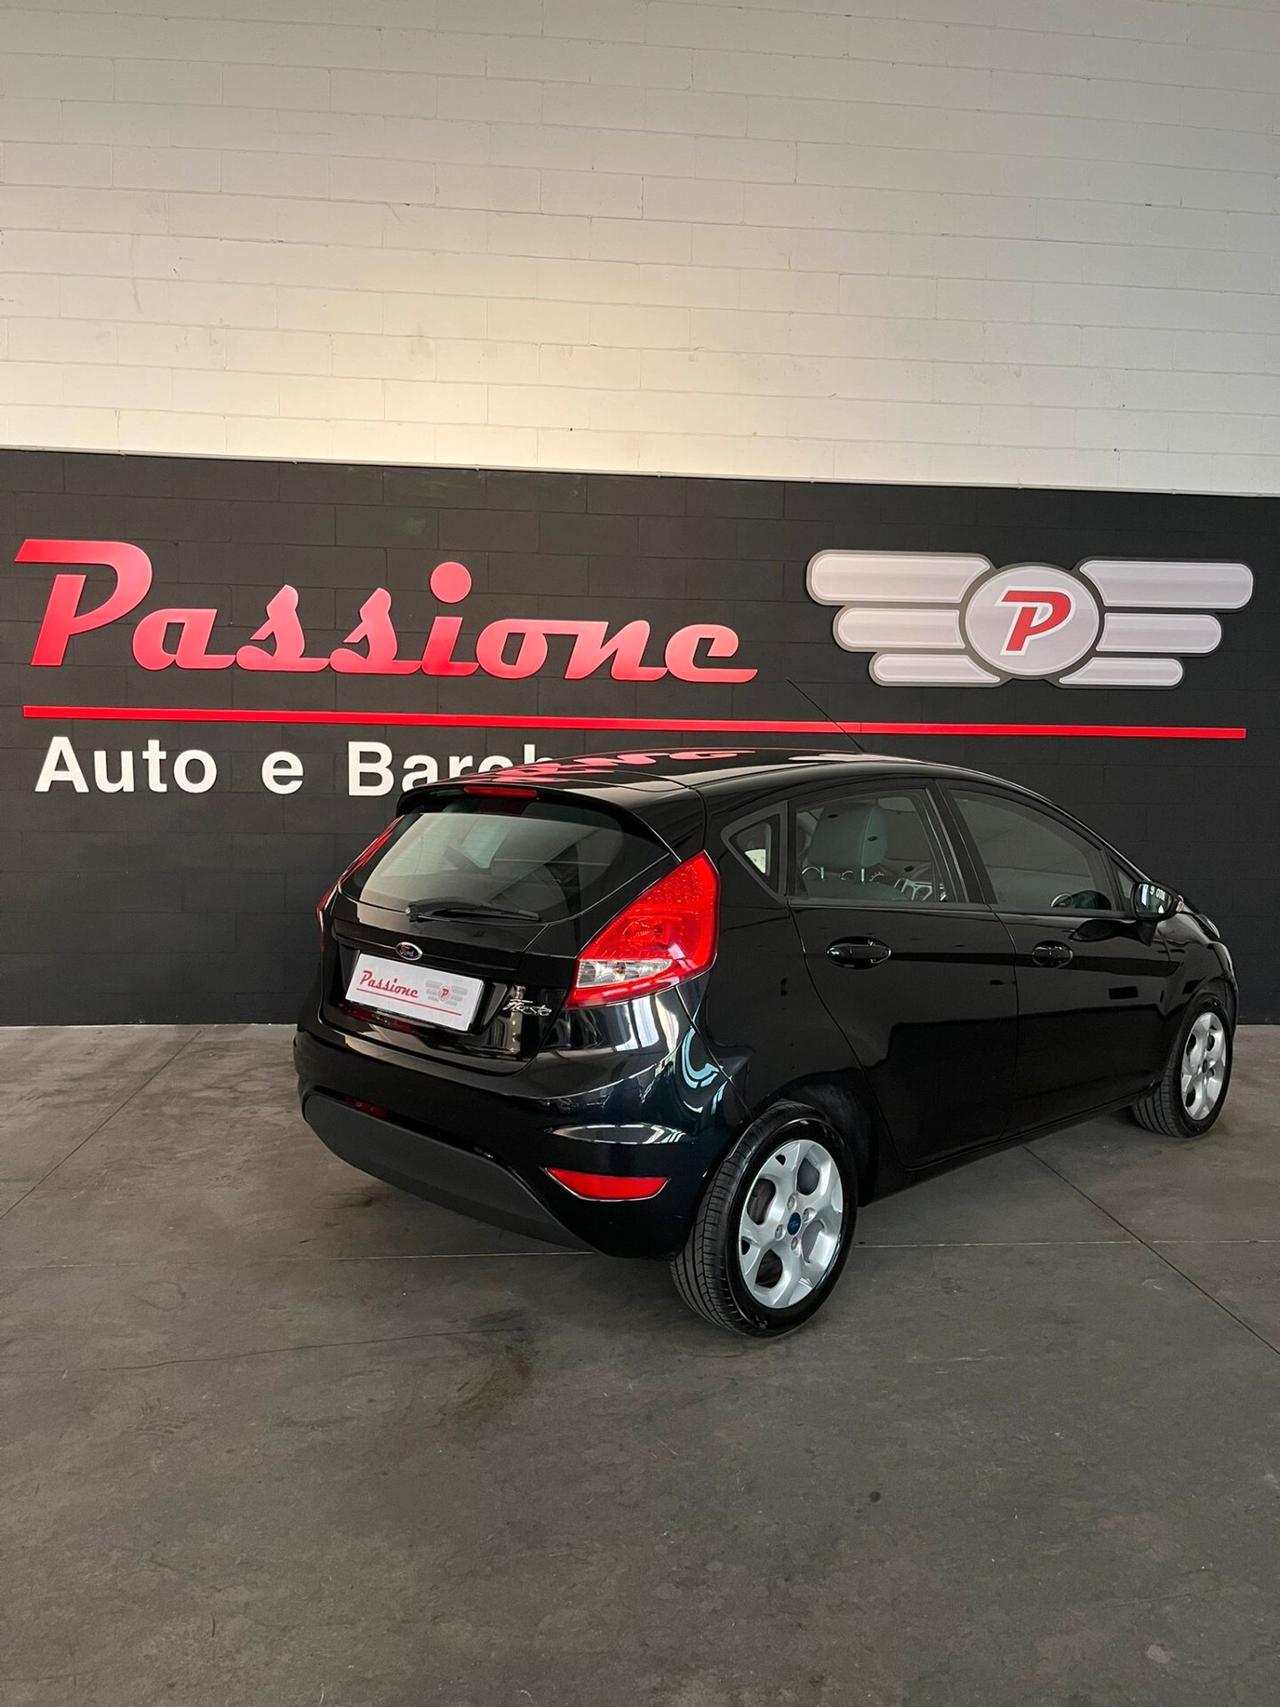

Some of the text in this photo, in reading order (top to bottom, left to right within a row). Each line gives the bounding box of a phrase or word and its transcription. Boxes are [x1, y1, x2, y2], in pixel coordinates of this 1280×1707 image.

[14, 538, 758, 684] Passione
[1001, 590, 1073, 653] P
[35, 735, 218, 794] Auto
[261, 750, 304, 796] e
[360, 970, 419, 999] Passione
